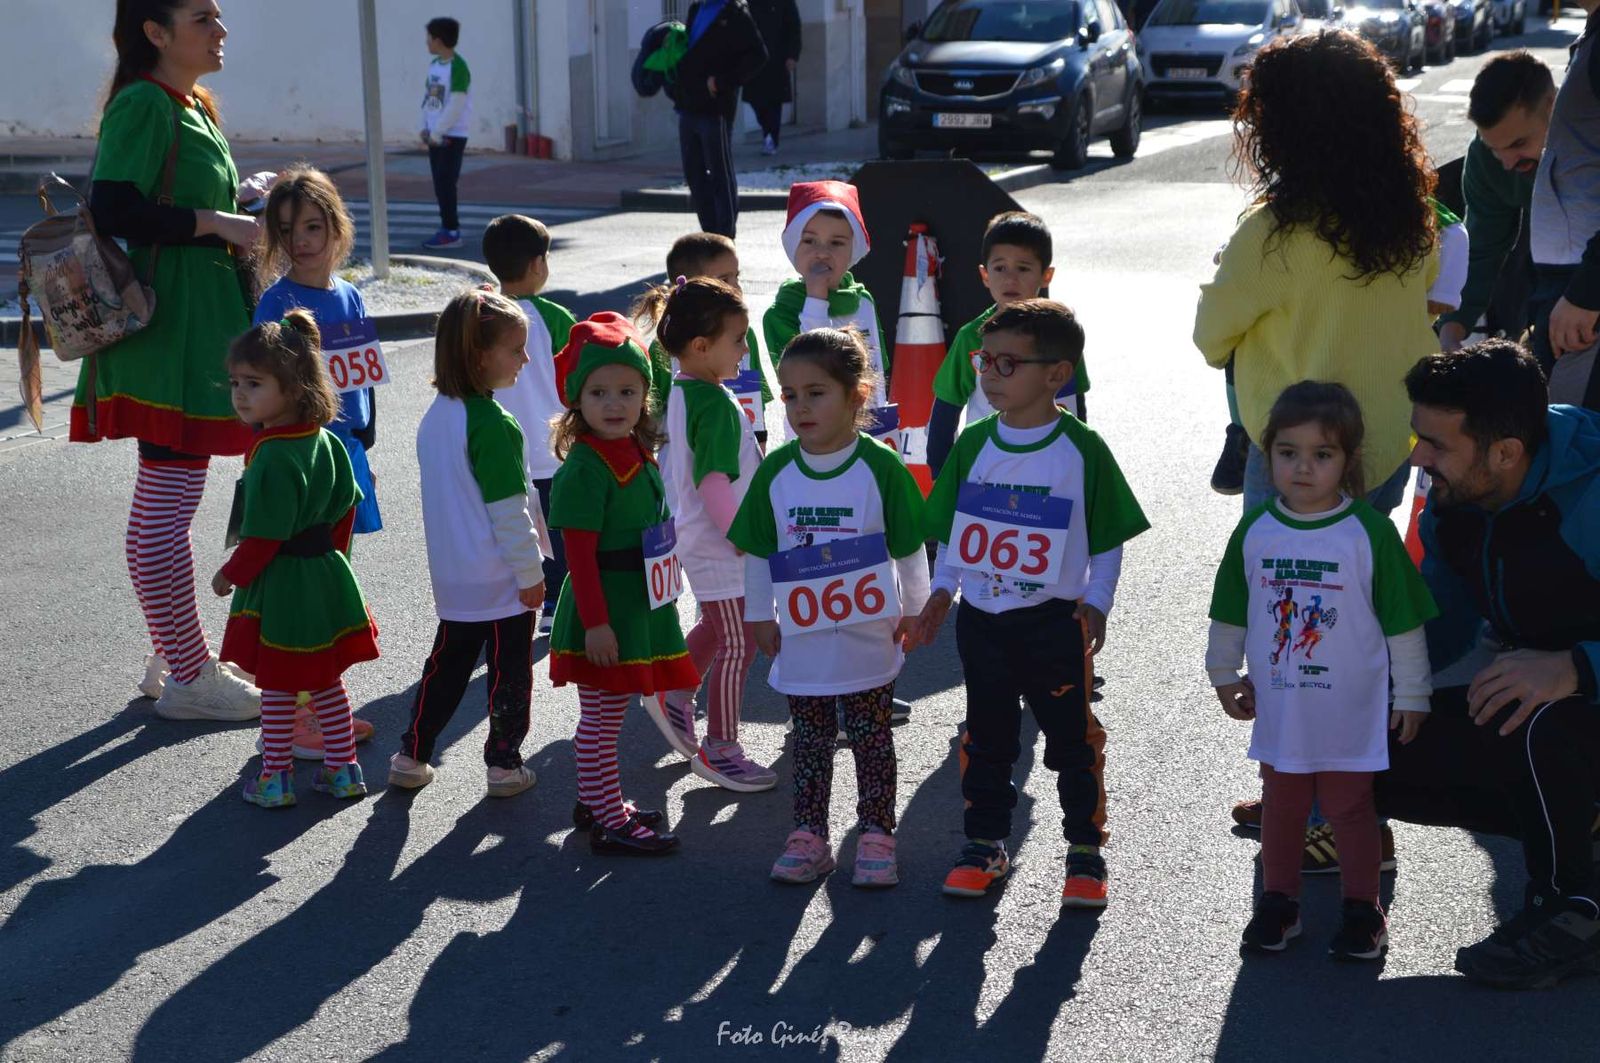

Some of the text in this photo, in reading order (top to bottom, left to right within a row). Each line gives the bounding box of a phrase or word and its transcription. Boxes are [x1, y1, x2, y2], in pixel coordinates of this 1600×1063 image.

[328, 348, 383, 389] 058
[959, 522, 1052, 576] 063
[651, 553, 681, 602] 070
[788, 572, 886, 628] 066
